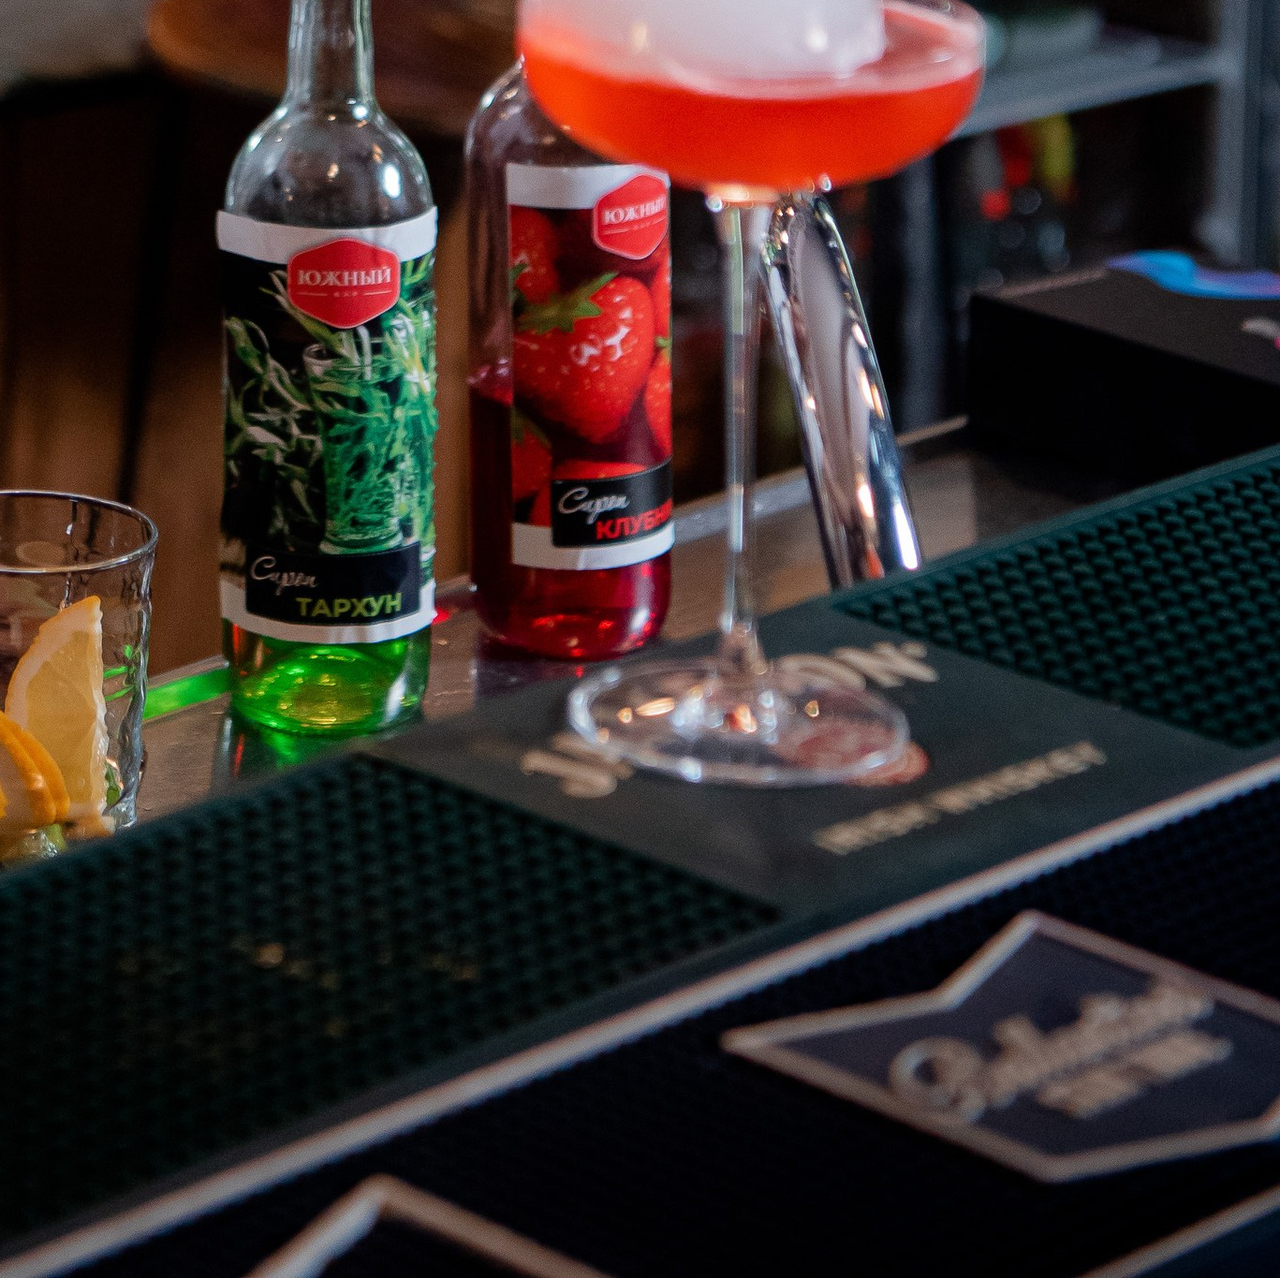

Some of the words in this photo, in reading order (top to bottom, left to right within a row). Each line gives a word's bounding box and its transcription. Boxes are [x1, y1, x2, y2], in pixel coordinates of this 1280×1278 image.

[297, 266, 391, 287] ЮЖНЫЙ
[250, 556, 319, 596] Сироп
[295, 592, 402, 618] ТАРХУН
